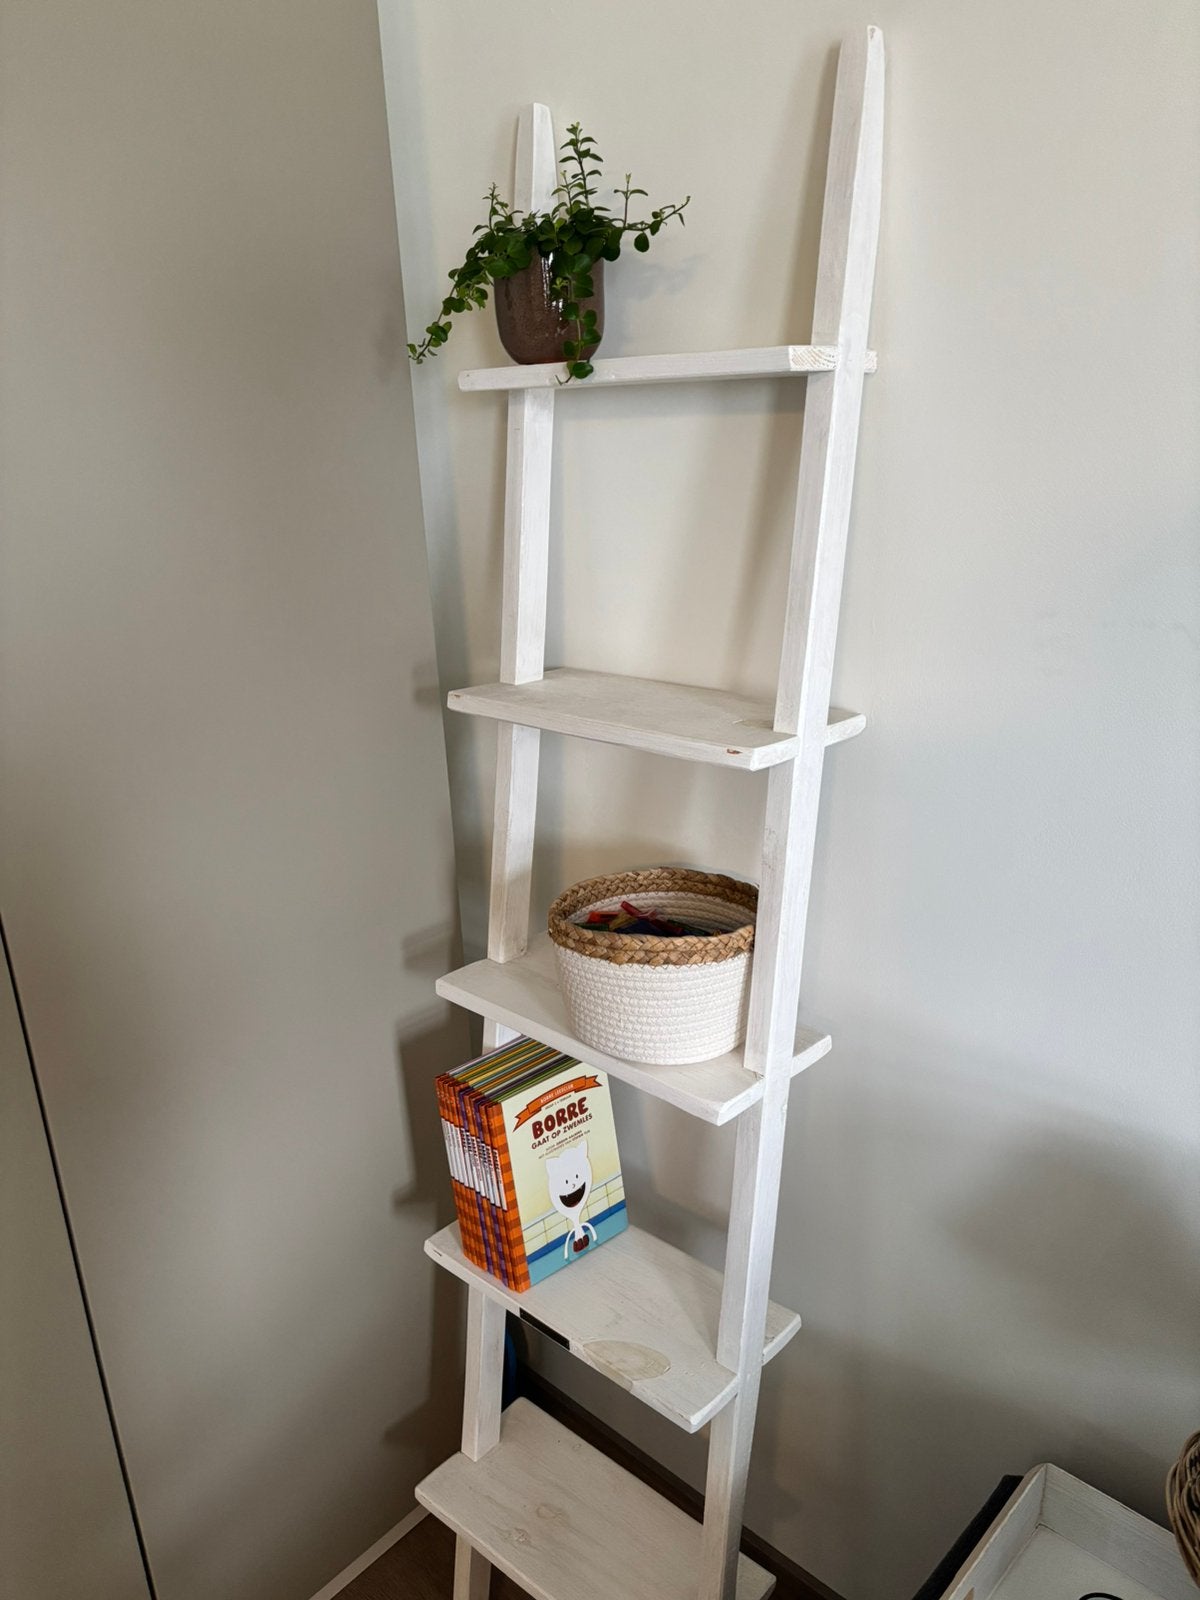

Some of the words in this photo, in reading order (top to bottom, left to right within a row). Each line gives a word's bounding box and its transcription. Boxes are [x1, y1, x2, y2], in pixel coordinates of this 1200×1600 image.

[531, 1136, 550, 1149] GAAT
[551, 1130, 561, 1139] OP
[563, 1113, 593, 1133] ZWEMLES
[532, 1097, 589, 1139] BORRE
